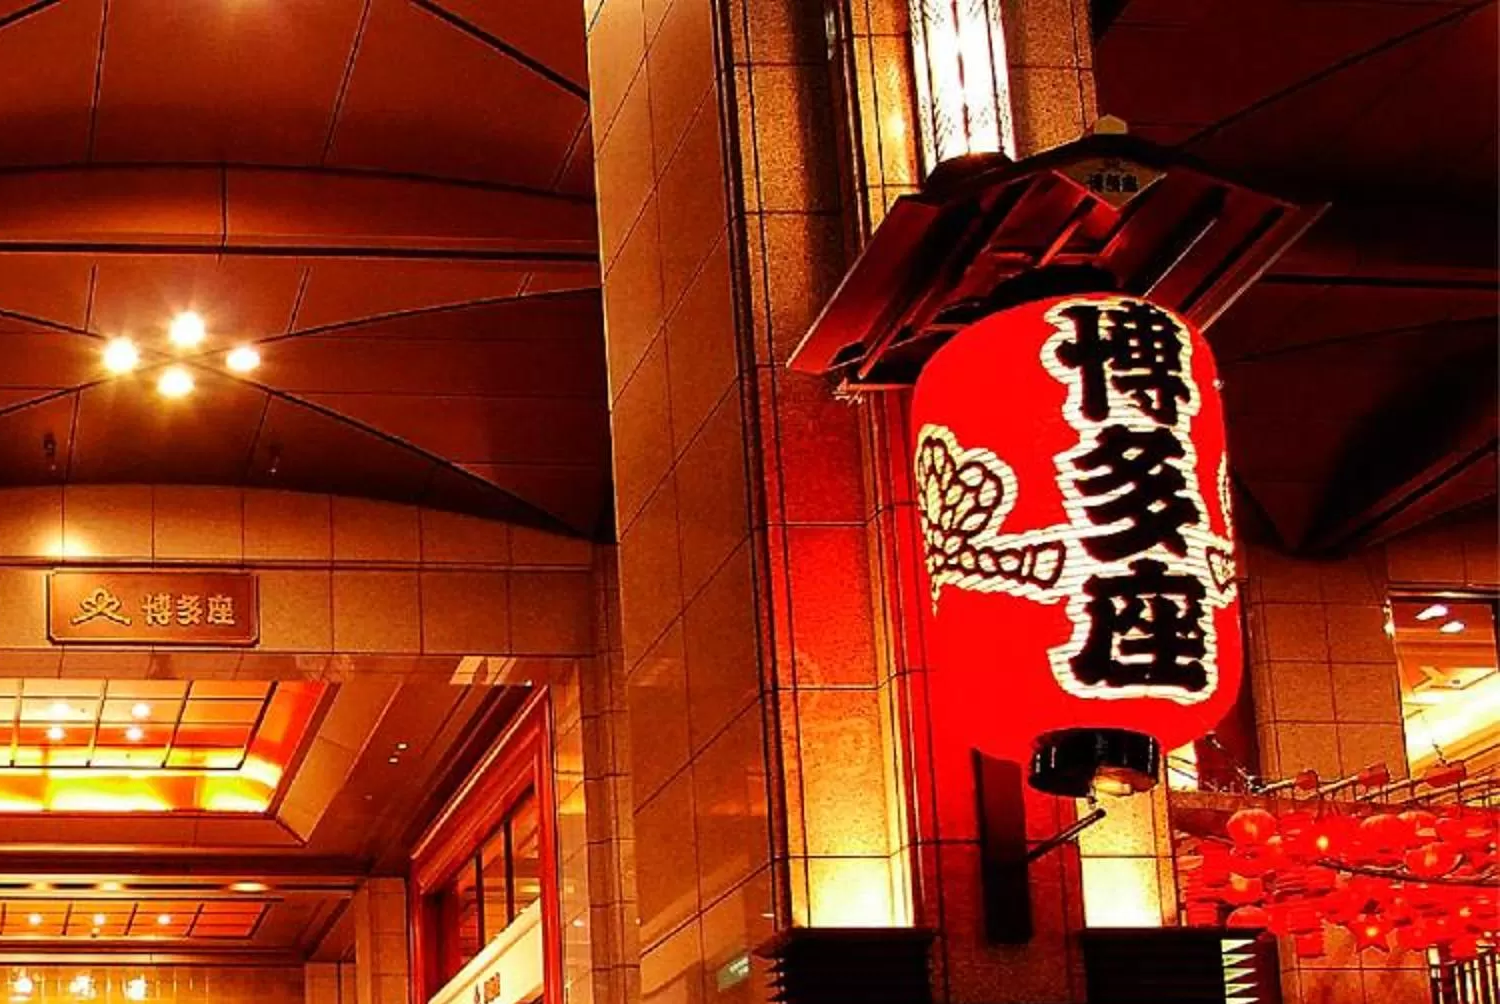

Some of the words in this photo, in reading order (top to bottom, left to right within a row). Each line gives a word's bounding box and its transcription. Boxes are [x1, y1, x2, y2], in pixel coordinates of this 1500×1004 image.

[1054, 300, 1209, 693] 博多座
[141, 593, 236, 627] 博多座
